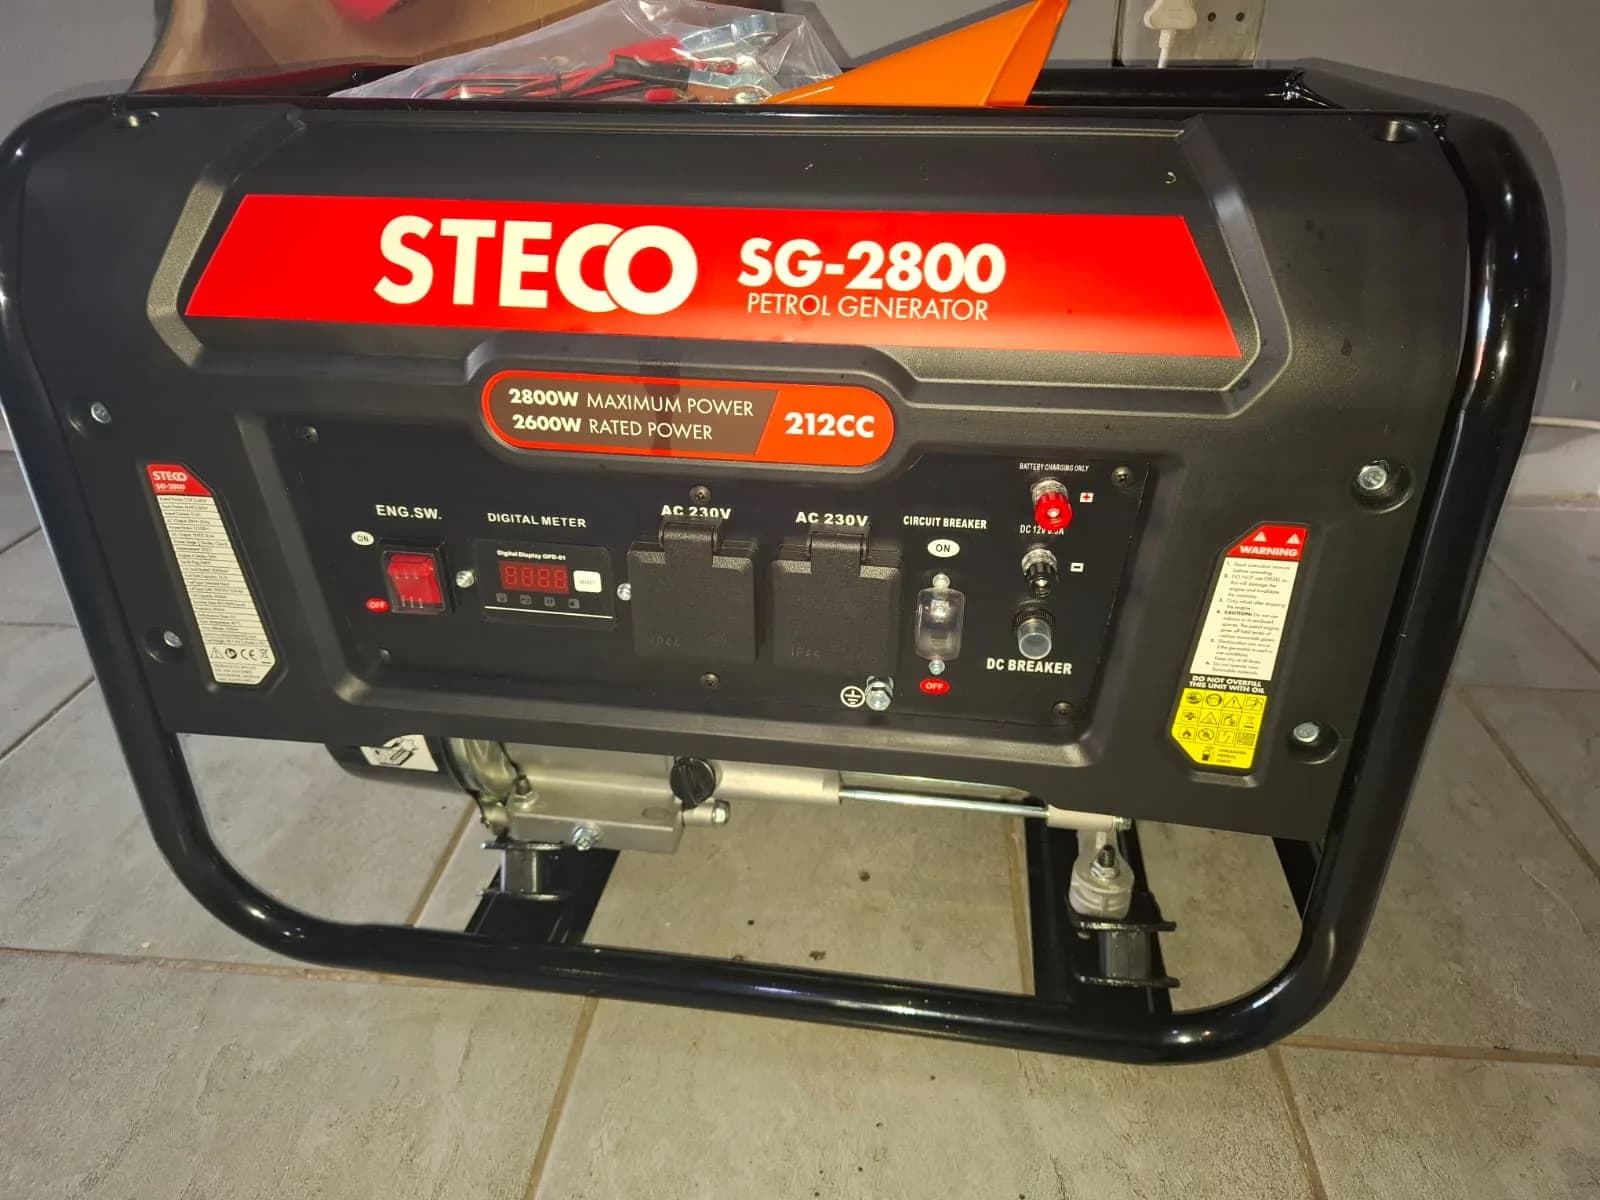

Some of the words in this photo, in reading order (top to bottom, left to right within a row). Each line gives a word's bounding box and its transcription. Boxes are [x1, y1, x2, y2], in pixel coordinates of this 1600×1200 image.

[373, 215, 698, 315] STECO
[737, 237, 1006, 294] SG-2800
[747, 292, 831, 316] PETROL
[838, 295, 988, 321] GENERATOR
[508, 388, 579, 407] 2800W
[587, 392, 682, 413] MAXIMUM
[687, 398, 753, 417] POWER
[512, 414, 582, 433] 2600W
[589, 418, 642, 437] RATED
[647, 422, 713, 440] POWER
[784, 411, 875, 438] 212CC
[1019, 462, 1044, 472] BATTERY
[1044, 463, 1073, 472] CHARGING
[1074, 464, 1089, 472] ONLY
[152, 471, 187, 482] STECO
[487, 512, 539, 526] DIGITAL
[541, 516, 587, 528] METER
[661, 505, 684, 517] AC
[689, 506, 732, 520] 230V
[795, 511, 819, 524] AC
[824, 513, 869, 527] 230V
[903, 515, 942, 527] CIRCUIT
[943, 518, 988, 530] BREAKER
[1020, 524, 1032, 534] DC
[356, 534, 370, 543] ON
[935, 543, 951, 553] ON
[1240, 545, 1298, 557] WARNING
[369, 600, 386, 610] OFF
[986, 657, 1004, 671] DC
[1008, 660, 1073, 675] BREAKER
[925, 682, 943, 690] OFF
[1192, 675, 1206, 683] DO
[1207, 676, 1226, 684] NOT
[1226, 678, 1262, 688] OVERFILL
[1207, 682, 1227, 691] UNIT
[1228, 684, 1250, 692] WITH
[1251, 686, 1265, 694] OIL
